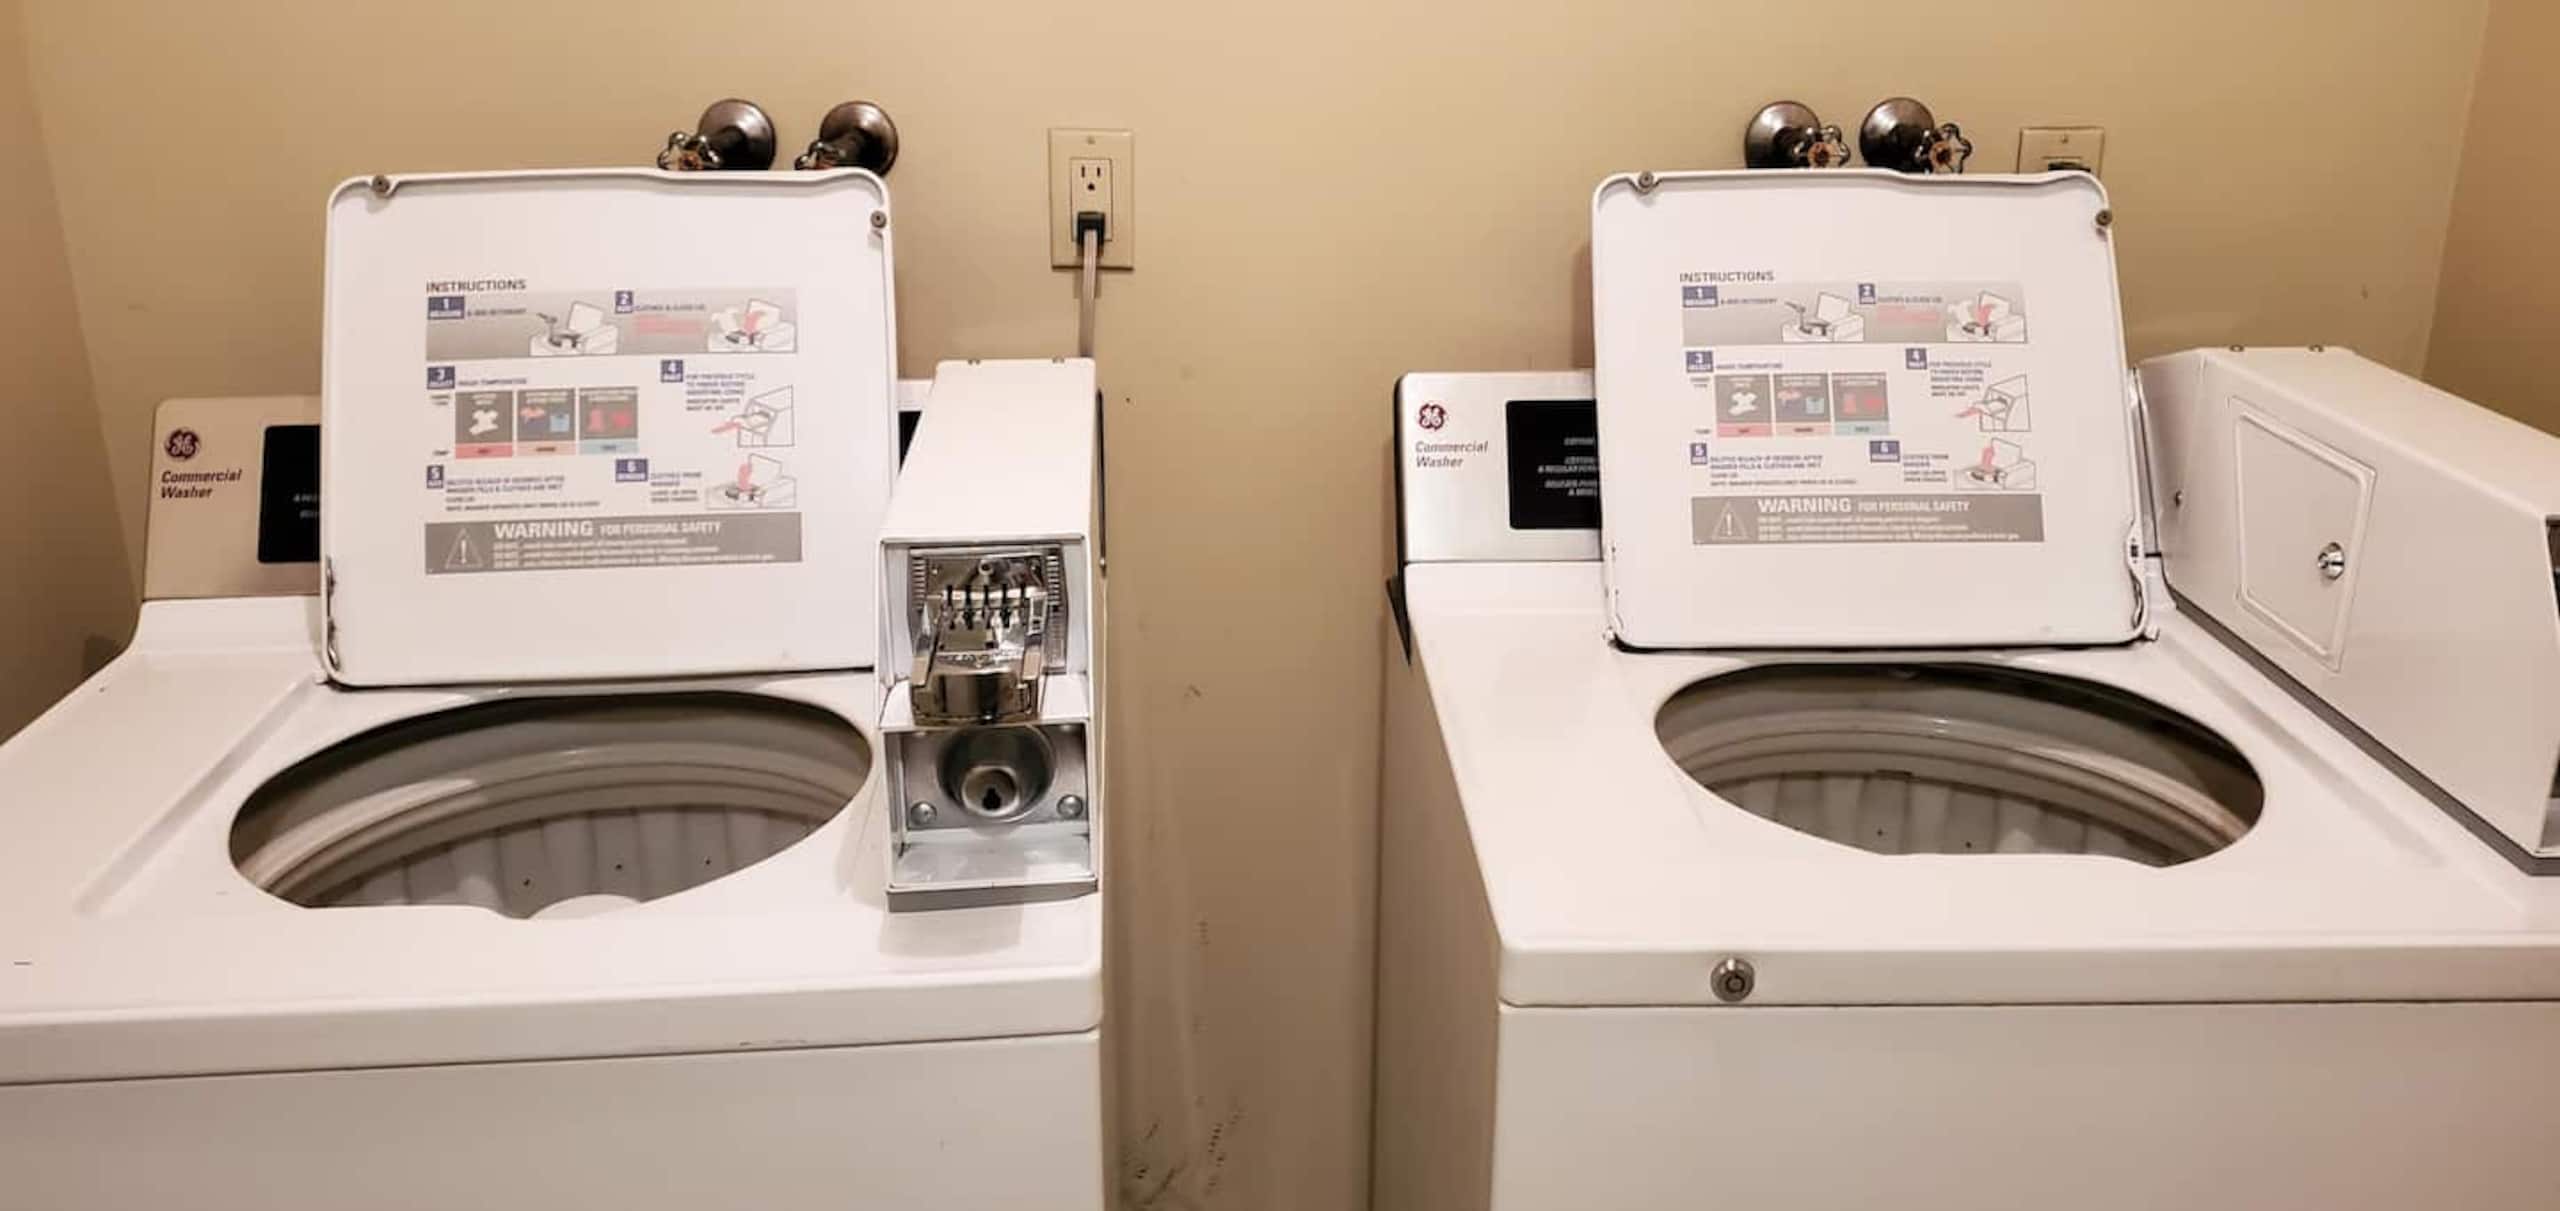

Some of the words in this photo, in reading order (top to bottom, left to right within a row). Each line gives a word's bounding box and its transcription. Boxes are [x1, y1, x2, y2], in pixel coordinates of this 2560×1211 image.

[1680, 271, 1775, 283] INSTRUCTIONS
[426, 279, 527, 293] INSTRUCTIONS
[443, 298, 450, 310] 1
[620, 293, 629, 305] 2
[1695, 352, 1704, 364] 3
[668, 361, 677, 373] 4
[1415, 440, 1489, 453] Commercial
[1415, 456, 1464, 468] Washer
[161, 468, 243, 484] Commercial
[430, 467, 440, 480] 5
[161, 486, 213, 499] Washer
[1758, 497, 1852, 513] WARNING
[494, 520, 593, 539] WARNING
[600, 523, 621, 536] FOR
[623, 522, 680, 536] PERSONAL
[682, 520, 721, 534] SAFETY
